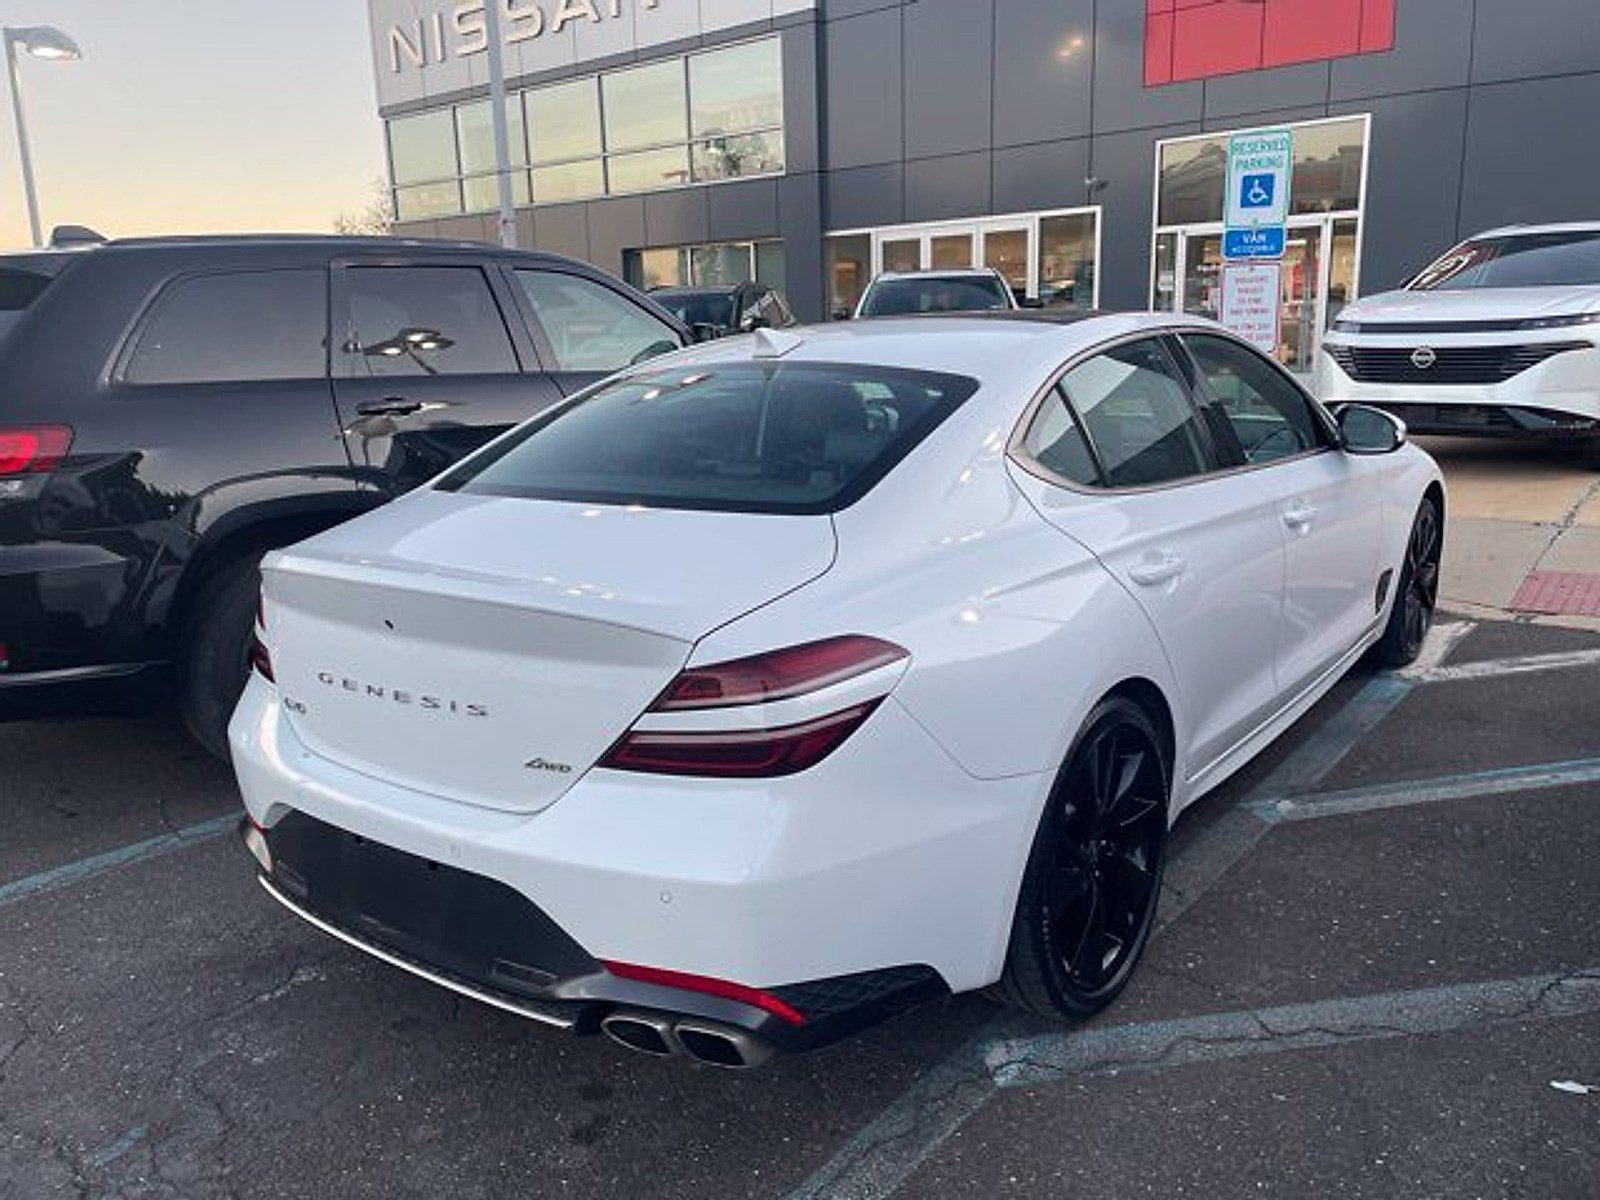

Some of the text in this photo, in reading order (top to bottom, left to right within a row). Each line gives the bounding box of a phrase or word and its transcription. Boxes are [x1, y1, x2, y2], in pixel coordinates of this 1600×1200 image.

[1236, 155, 1282, 170] PARKING
[1242, 233, 1266, 244] VAN
[318, 672, 488, 716] GENESIS
